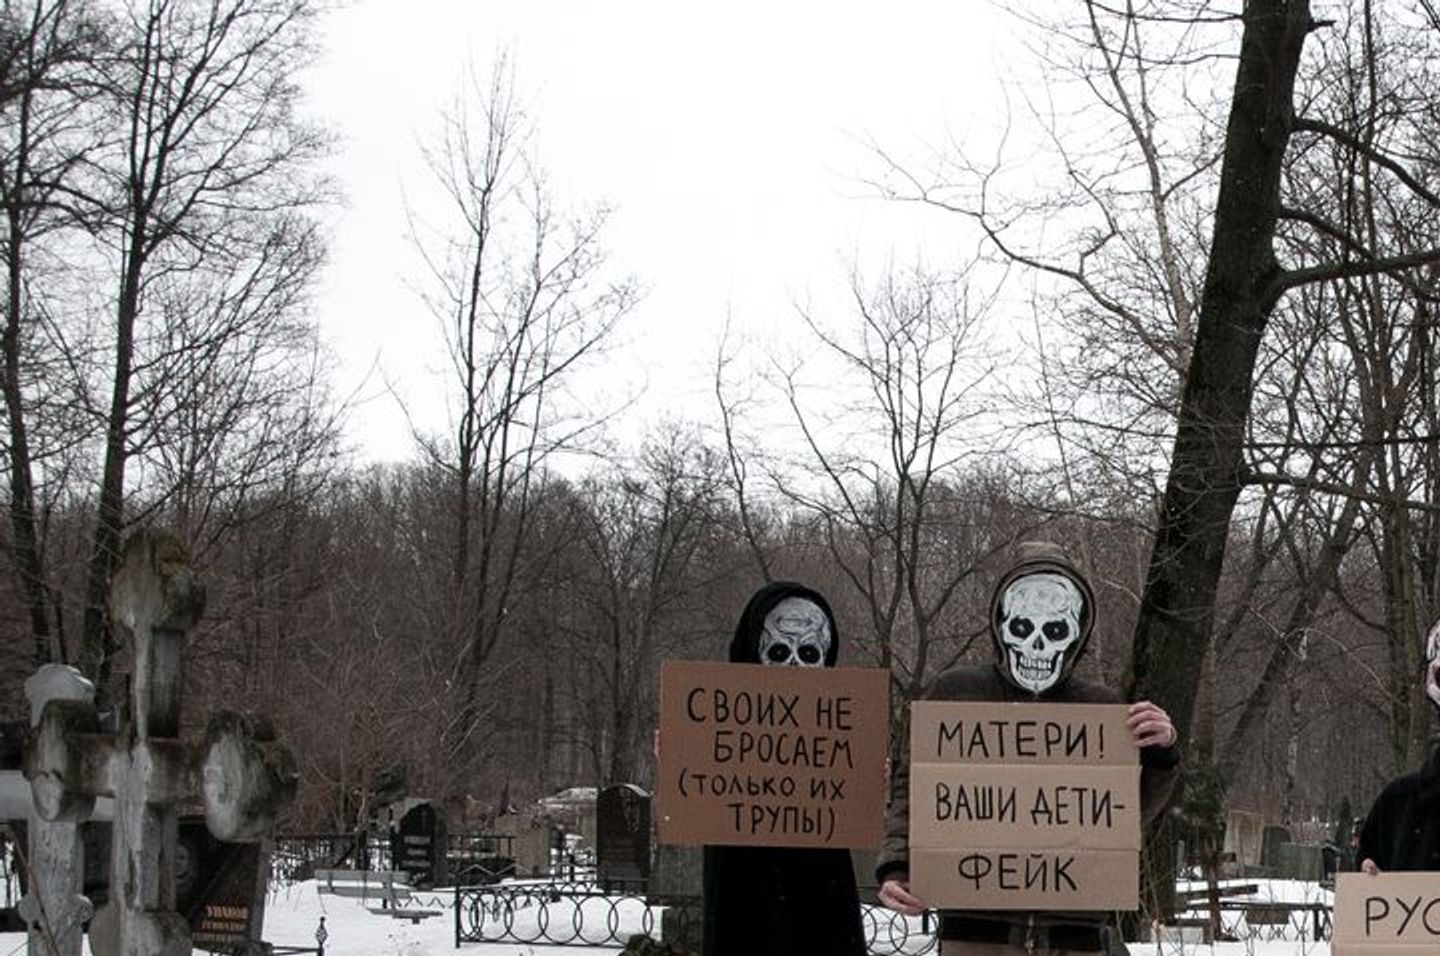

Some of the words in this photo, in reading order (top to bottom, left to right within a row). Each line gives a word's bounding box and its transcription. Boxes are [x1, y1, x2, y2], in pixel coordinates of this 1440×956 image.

[686, 687, 799, 727] СВОИХ
[816, 697, 853, 730] НЕ
[713, 730, 854, 769] БРОСАЕМ
[937, 720, 1104, 759] МАТЕРИ!
[678, 773, 796, 798] (ТОЛЬКО
[810, 777, 845, 801] ИХ
[935, 781, 1016, 823] ВАШИ
[1030, 786, 1126, 828] ДЕТИ-
[728, 802, 836, 841] ТРУПЫ)
[957, 852, 1078, 892] ФЕЙК
